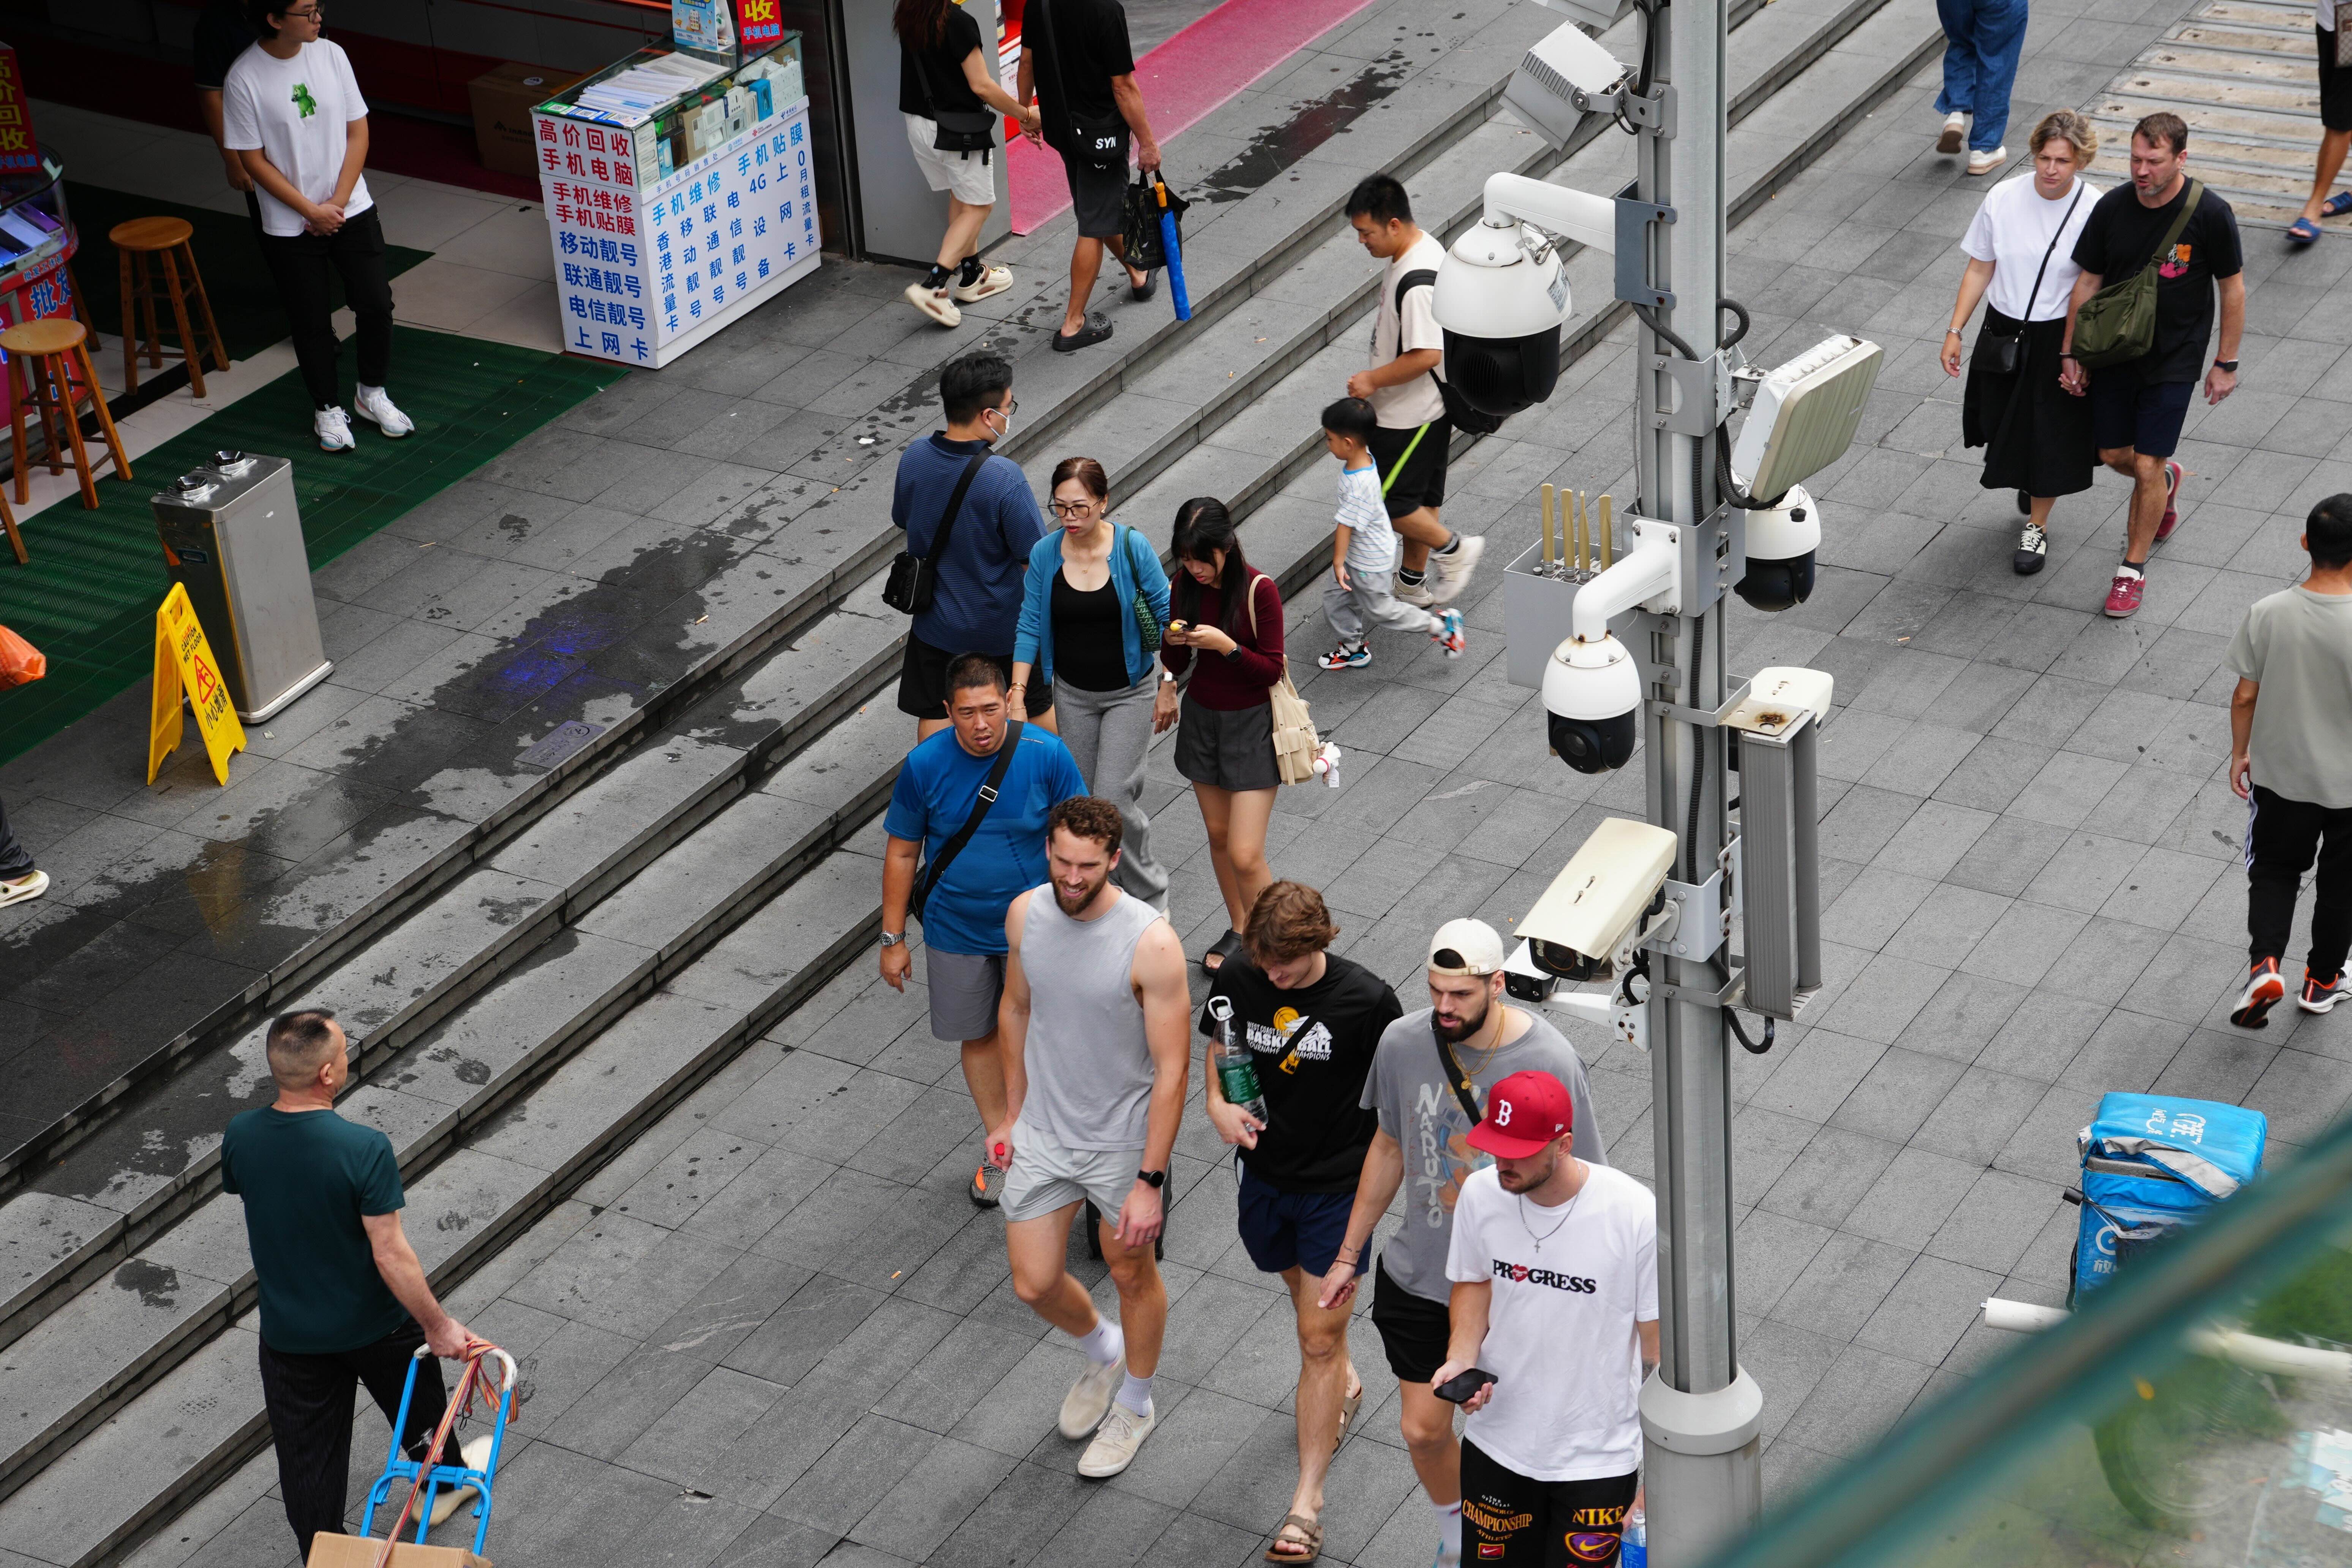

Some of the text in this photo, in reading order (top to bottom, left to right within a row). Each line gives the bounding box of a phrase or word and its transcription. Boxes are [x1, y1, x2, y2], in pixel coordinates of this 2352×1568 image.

[743, 23, 780, 40] 手机电脑
[538, 119, 630, 158] 高价回收
[1095, 136, 1116, 149] SYN
[543, 148, 634, 187] 手机电脑
[653, 122, 803, 227] 手机维修 手机贴膜
[656, 152, 718, 194] 手机号码销售处
[553, 182, 633, 213] 手机维修
[776, 162, 796, 261] 上网卡
[556, 204, 636, 236] 手机贴膜
[559, 231, 638, 267] 移动靓号
[703, 202, 725, 304] 联通靓号
[727, 191, 748, 290] 电信靓号
[563, 262, 642, 299] 联通靓号
[657, 231, 679, 333] 香港流量卡
[680, 217, 702, 319] 移动靓号
[569, 295, 646, 330] 电信靓号
[575, 326, 648, 360] 上网卡
[181, 625, 197, 652] CAUTION
[190, 632, 202, 653] FLOOR
[204, 683, 228, 730] 小心地滑
[1247, 1020, 1260, 1031] WEST
[1260, 1025, 1276, 1035] COAST
[1495, 1099, 1512, 1126] B
[1415, 1083, 1446, 1228] NARUTO
[1462, 1499, 1533, 1532] CHAMPIONSHIP
[1478, 1502, 1506, 1514] SPONSOR
[1482, 1494, 1510, 1507] OFFICIAL
[1572, 1506, 1624, 1526] NIKE
[1476, 1528, 1513, 1541] ATHLETES
